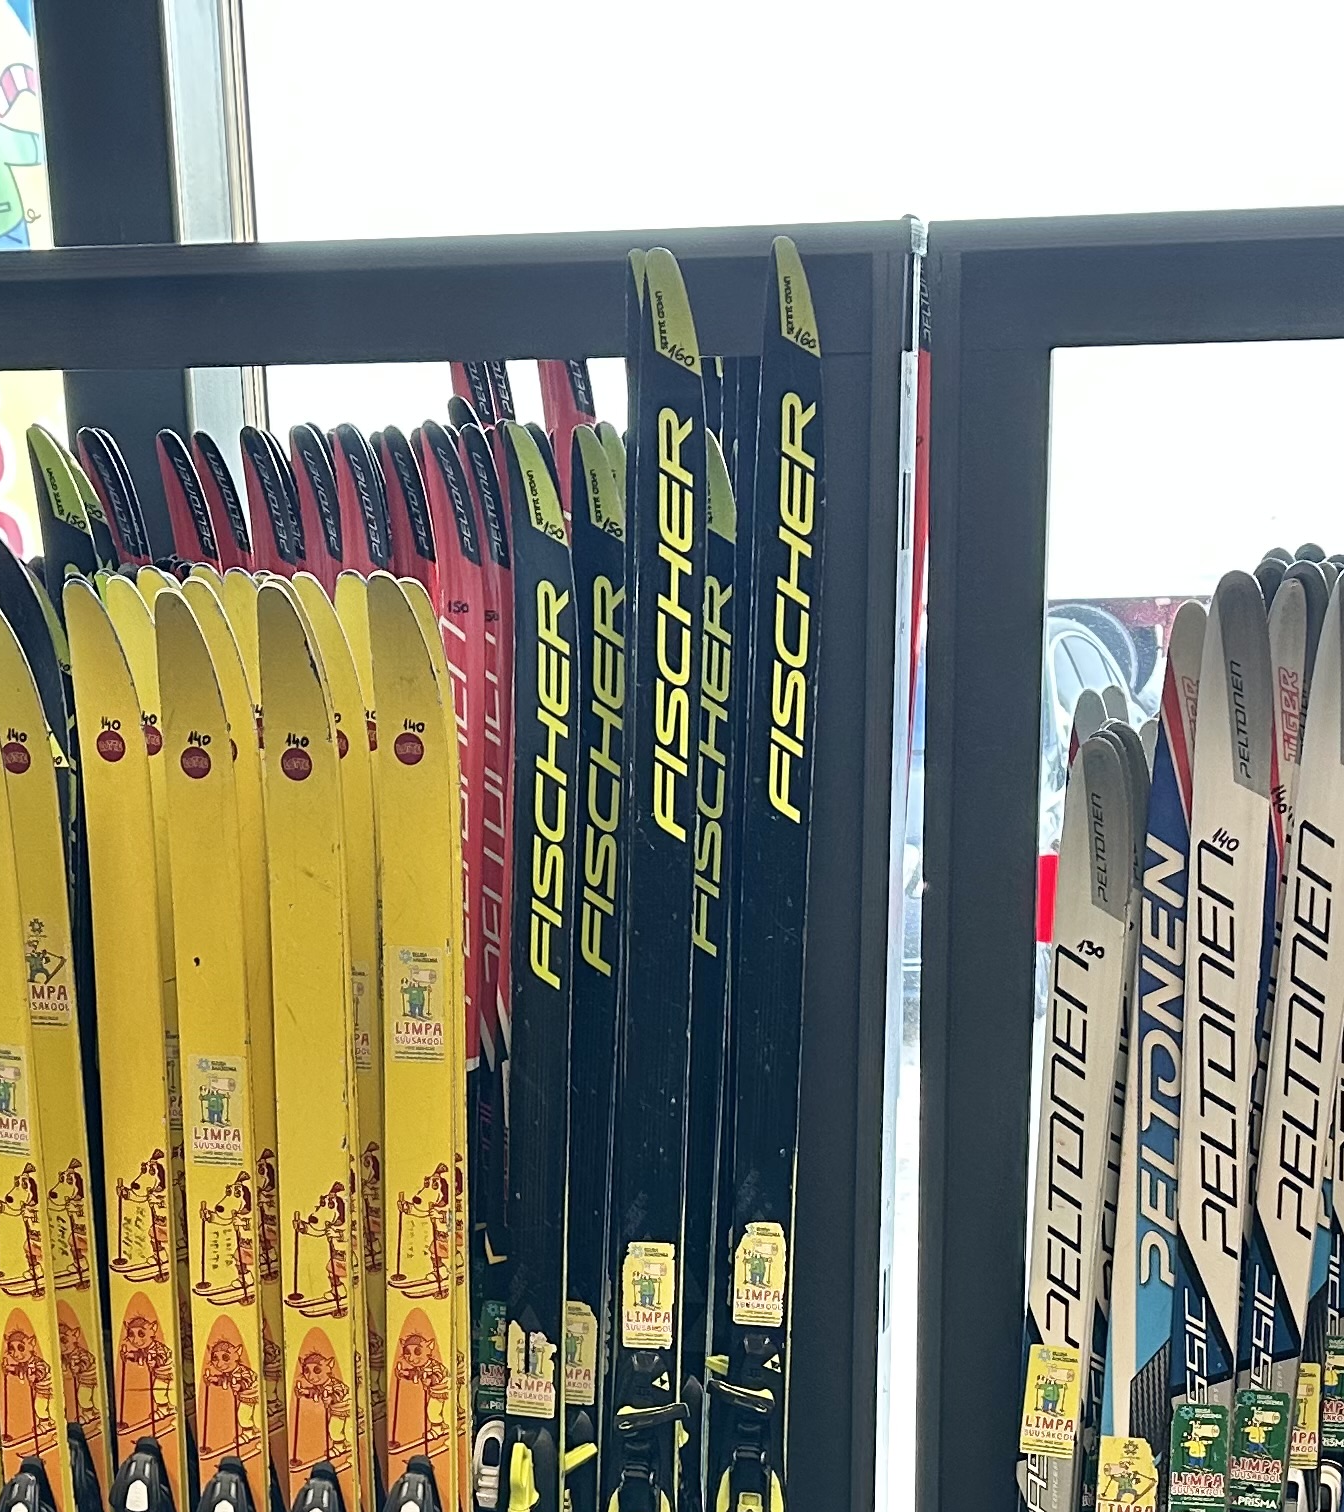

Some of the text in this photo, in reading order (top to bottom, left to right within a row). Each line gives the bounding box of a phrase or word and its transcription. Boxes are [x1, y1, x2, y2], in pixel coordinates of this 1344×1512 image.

[793, 329, 817, 350] 160
[667, 345, 696, 368] 160
[768, 391, 818, 825] FISCHER
[653, 407, 695, 843] FISCHER
[100, 716, 122, 731] 140
[403, 718, 425, 733] 140
[1229, 660, 1253, 778] PELTONEN
[7, 728, 28, 744] 140
[187, 730, 211, 747] 140
[285, 732, 310, 748] 140
[580, 574, 627, 977] FISCHER
[692, 575, 735, 958] FISCHER
[529, 579, 571, 991] FISCHER
[1090, 793, 1104, 902] PELTONEN
[1076, 938, 1105, 960] 130
[395, 1021, 444, 1037] LIMPA
[1276, 820, 1336, 1240] PELTONEN
[1197, 838, 1239, 1261] PELTONEN
[1139, 833, 1187, 1288] PELTONEN
[193, 1126, 242, 1143] LIMPA
[1044, 944, 1089, 1347] PELTONEN
[736, 1287, 783, 1303] LIMPA
[625, 1311, 673, 1325] LIMPA
[1024, 1416, 1075, 1434] LIMPA
[1230, 1457, 1282, 1477] LIMPA
[1171, 1472, 1225, 1490] LIMPA
[1237, 1495, 1279, 1510] PRISMA
